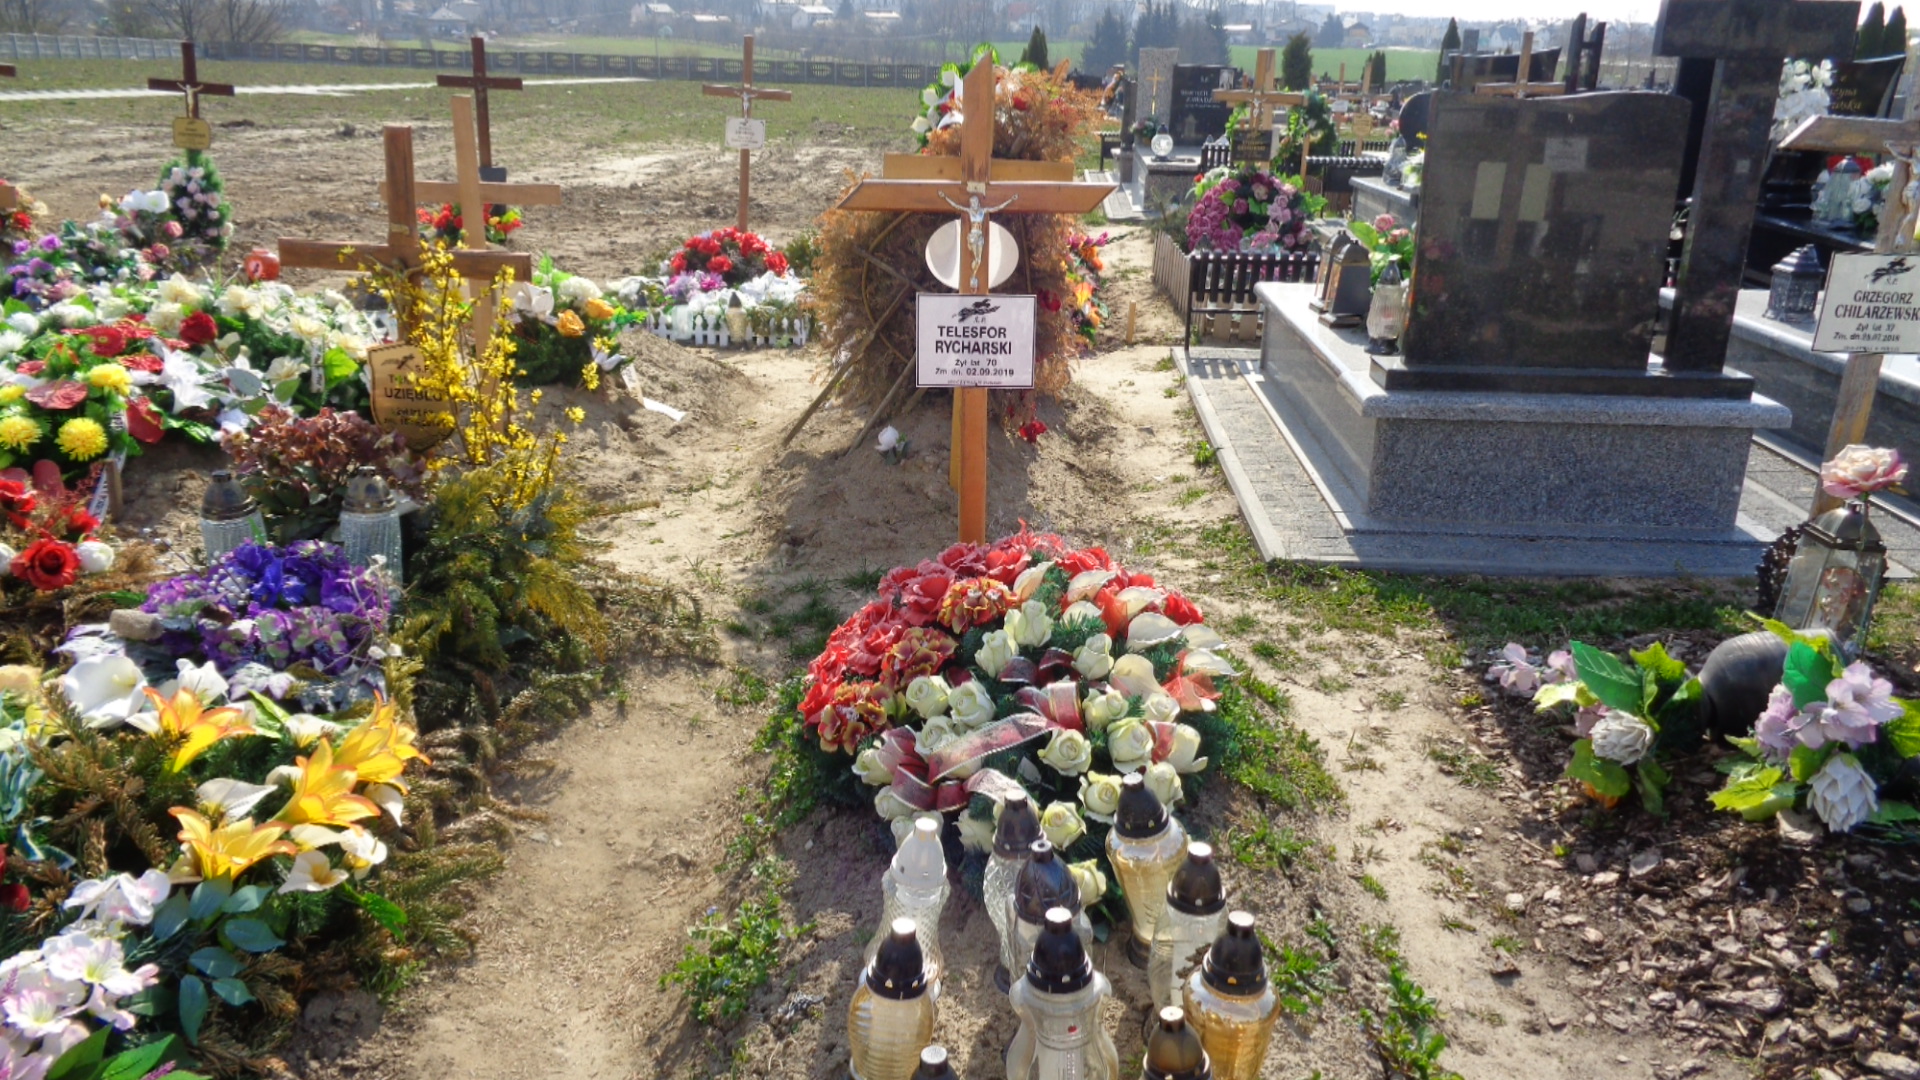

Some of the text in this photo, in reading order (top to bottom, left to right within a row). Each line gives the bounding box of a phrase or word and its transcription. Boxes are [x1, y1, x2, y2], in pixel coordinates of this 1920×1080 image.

[1853, 290, 1913, 304] GRZEGORZ
[1834, 304, 1920, 321] CHILARZEWSK
[937, 326, 1007, 339] TELESFOR
[935, 340, 1012, 355] RYCHARSKI
[986, 359, 997, 367] 70
[966, 367, 1014, 377] 02.09.2019
